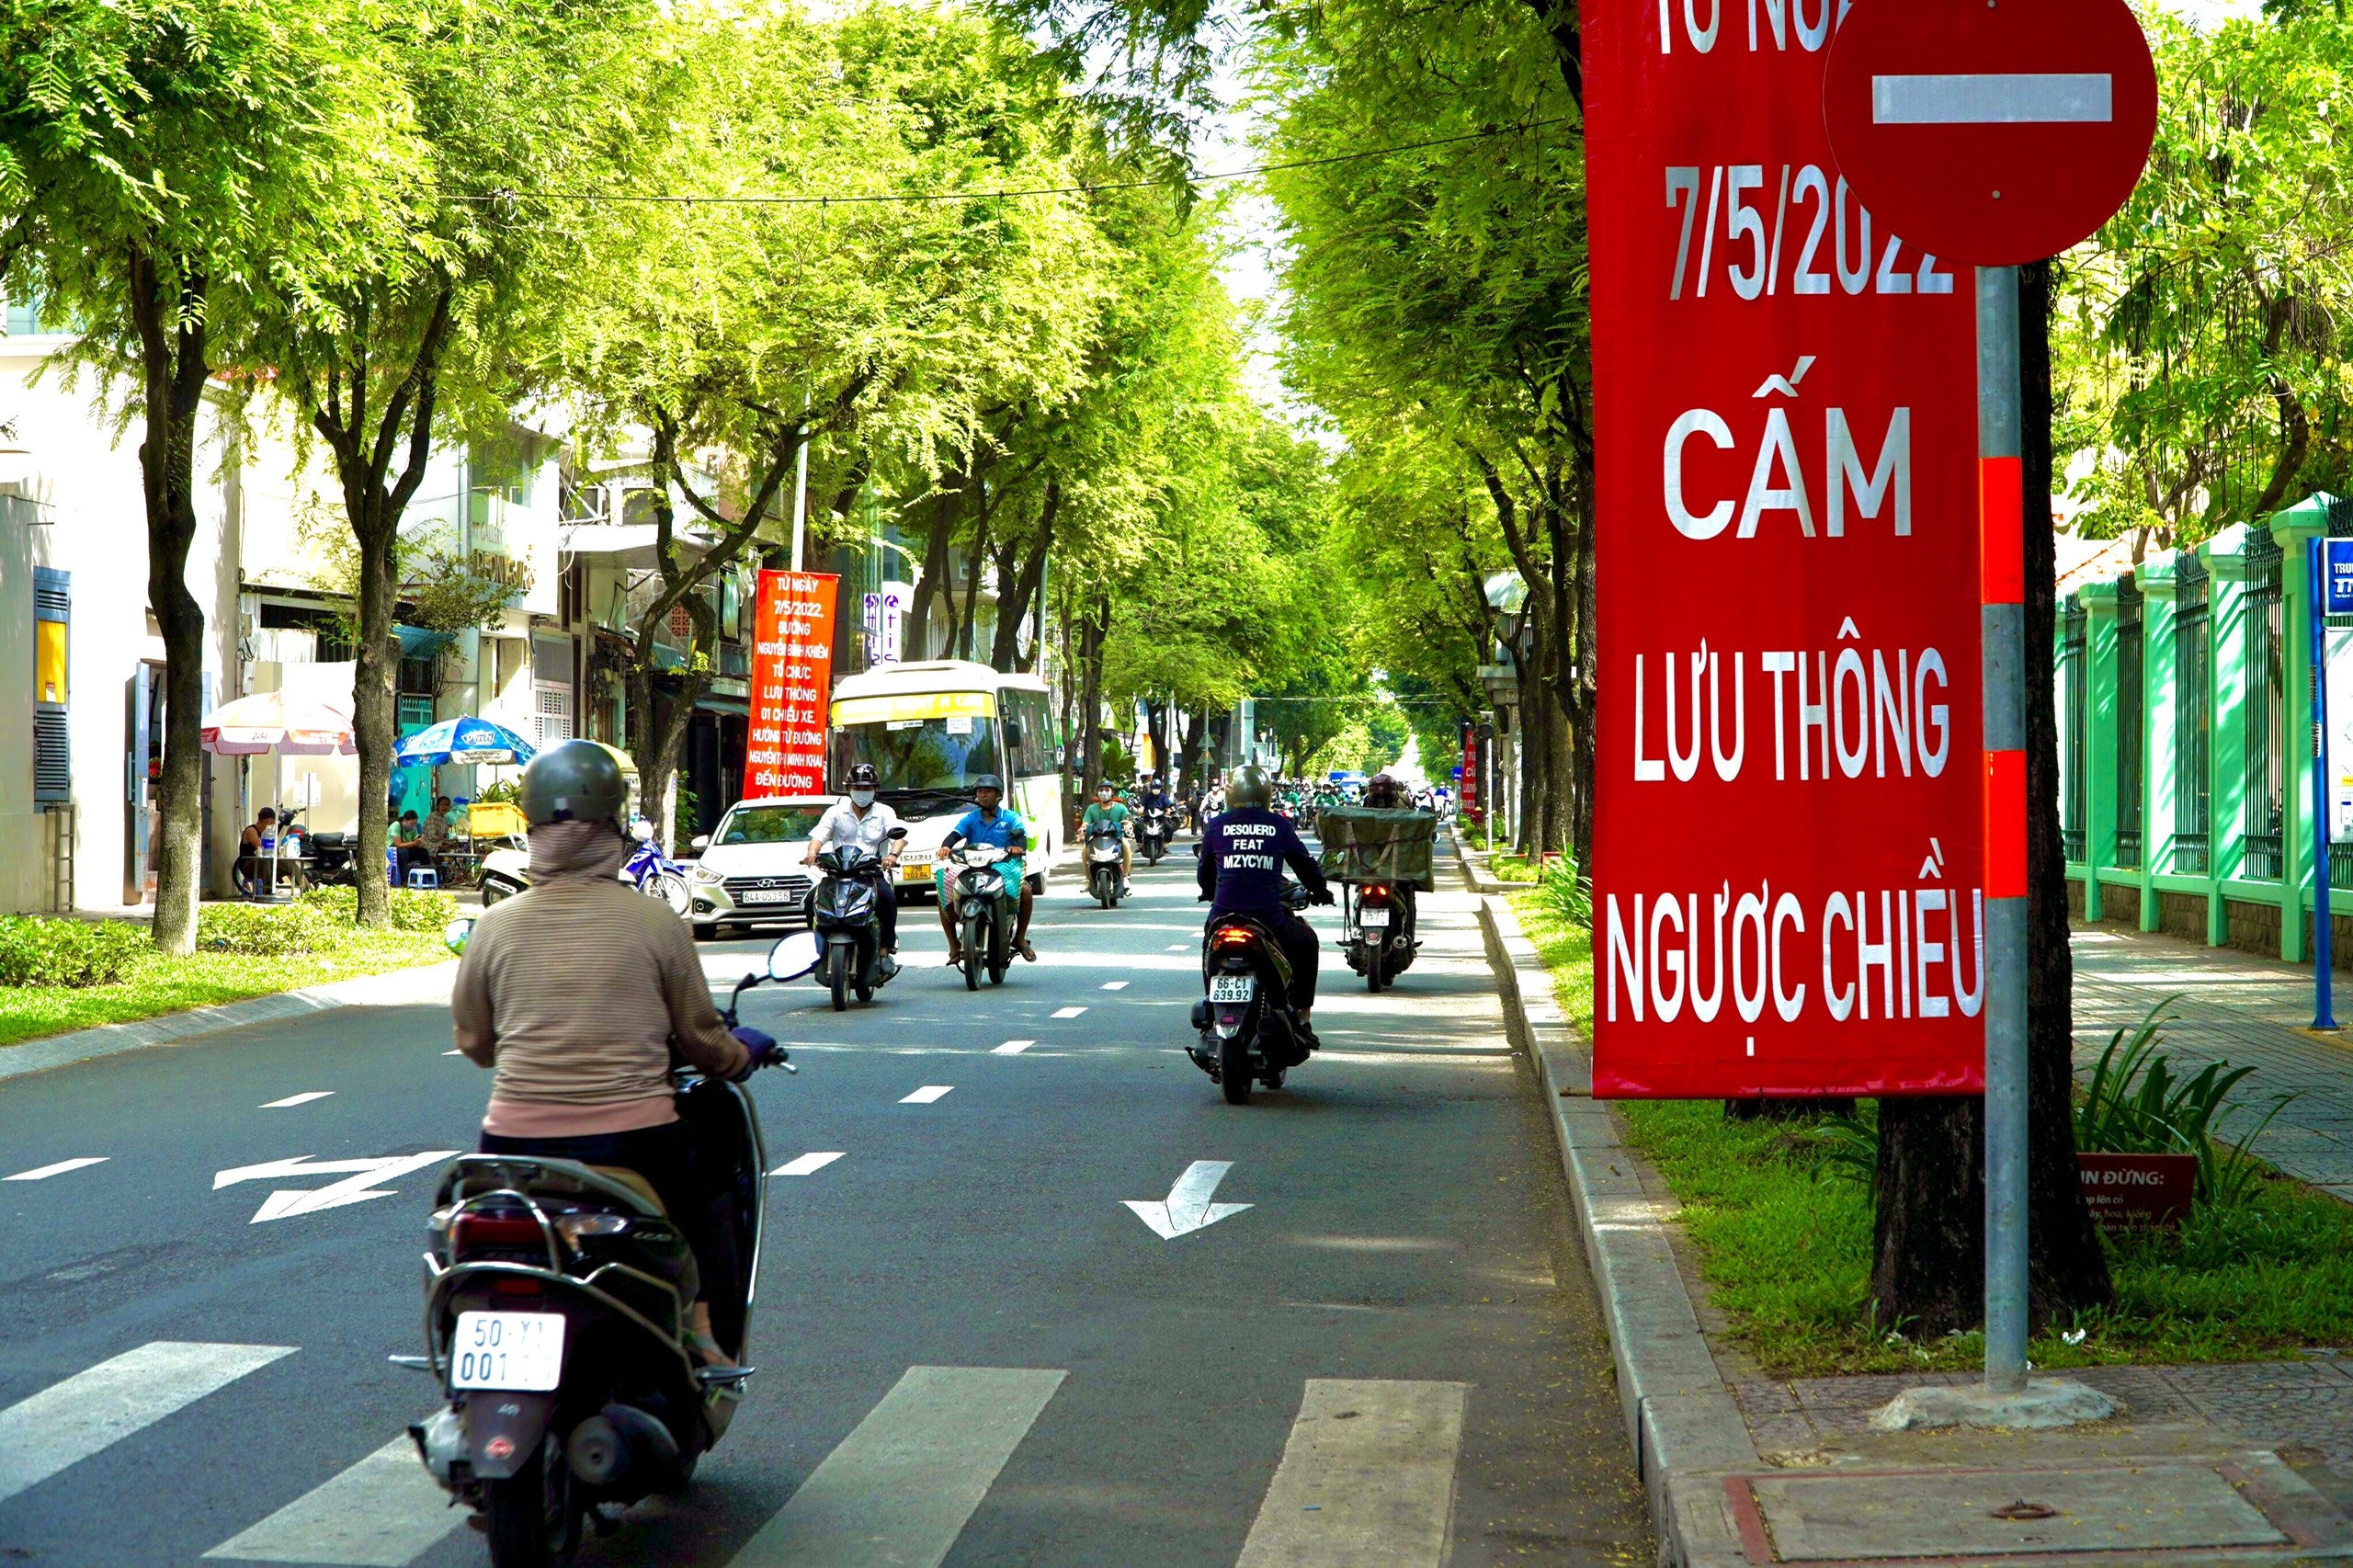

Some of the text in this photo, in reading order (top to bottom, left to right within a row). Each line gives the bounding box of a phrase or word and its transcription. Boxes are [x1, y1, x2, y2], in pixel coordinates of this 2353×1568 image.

[1663, 356, 1912, 540] CẤM
[2333, 562, 2353, 574] TRU
[777, 574, 819, 593] TỪ NGÀY
[778, 619, 811, 636] ĐƯỜNG
[772, 659, 812, 680] TỔ CHỨC
[764, 685, 817, 702] LƯU THÔNG
[1633, 637, 1745, 783] LƯU
[1762, 616, 1950, 782] THÔNG
[761, 707, 770, 721] 01
[773, 705, 800, 722] CHIỀU
[752, 725, 822, 745] HƯỚNG TỪ ĐƯỜNG
[787, 753, 804, 767] MINH
[806, 754, 824, 767] KHAI
[755, 768, 813, 789] ĐẾN ĐƯỜNG
[1222, 824, 1277, 837] DESQUERD
[1233, 839, 1264, 851] FEAT
[900, 854, 932, 862] ISUZU
[1223, 854, 1274, 870] MZYCYM
[1607, 837, 1984, 1057] NGƯỢC CHIỀU
[1217, 977, 1246, 989] 66-C1
[1213, 989, 1249, 1001] 639.92
[2103, 1168, 2165, 1186] ĐỪNG:
